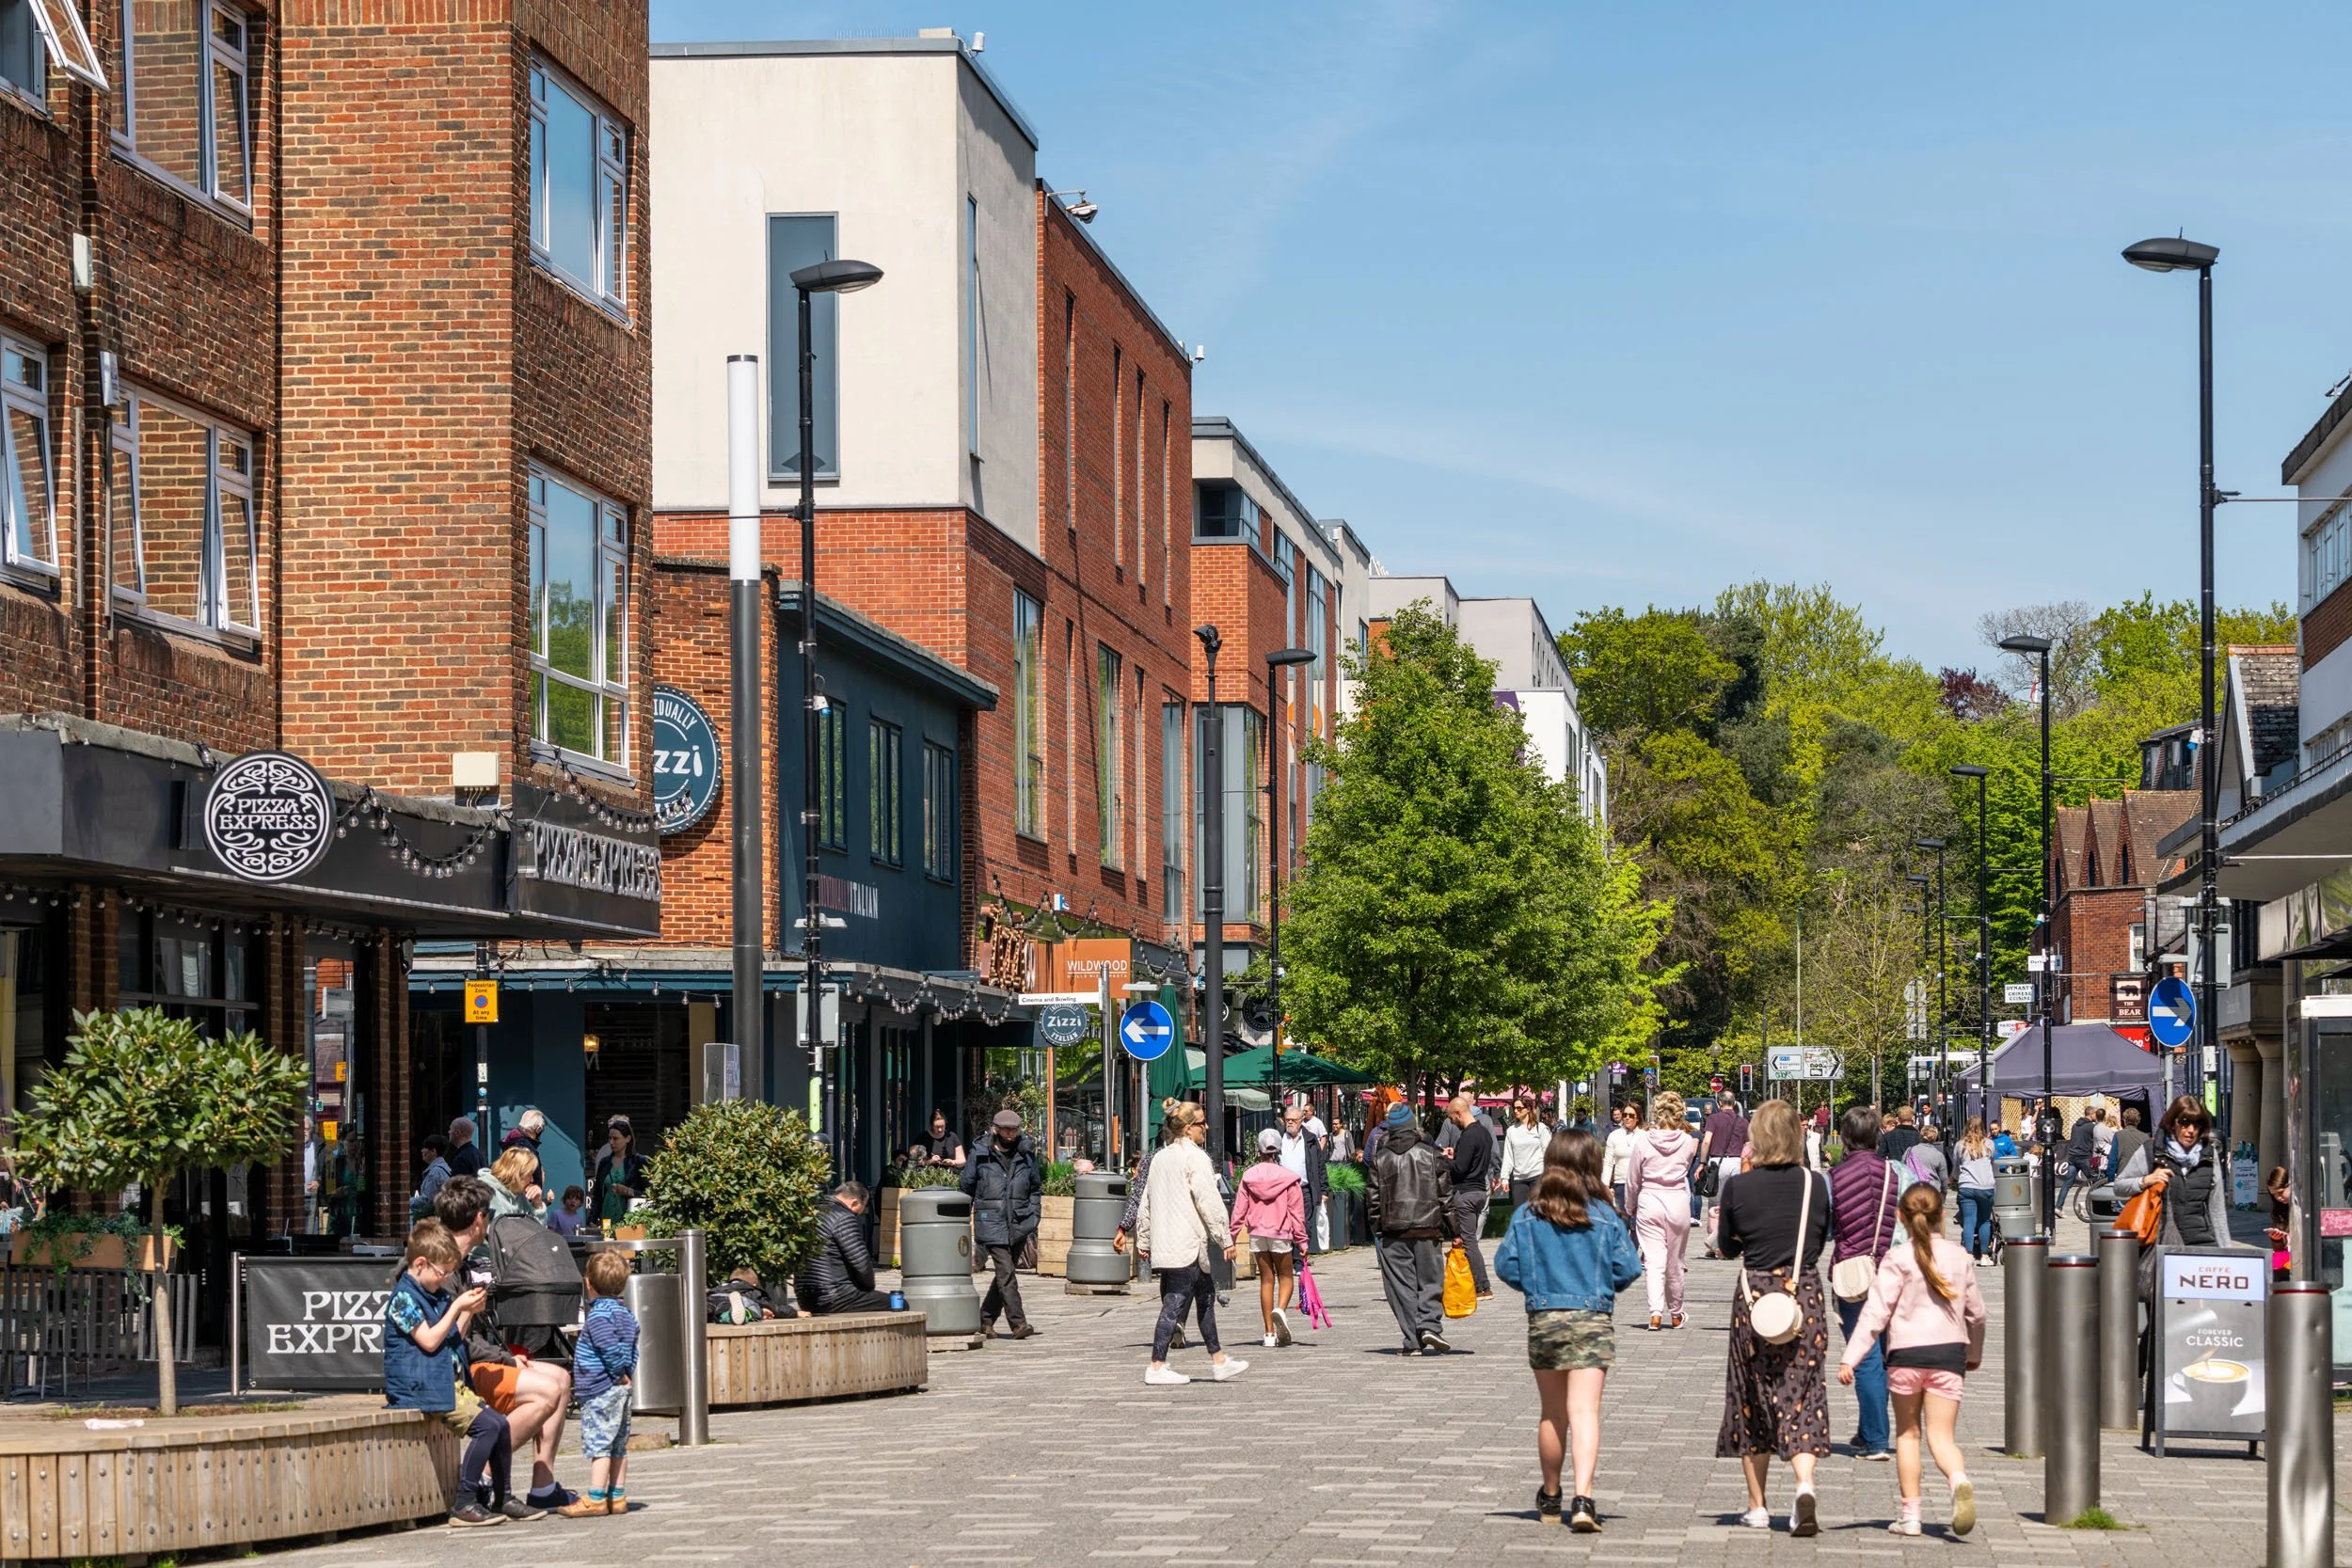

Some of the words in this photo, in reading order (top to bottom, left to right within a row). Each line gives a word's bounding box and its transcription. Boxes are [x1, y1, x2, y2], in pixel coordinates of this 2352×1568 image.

[237, 799, 299, 814] PIZZA
[219, 815, 317, 830] EXPRESS
[850, 880, 879, 920] ITALIAN
[1067, 959, 1128, 972] WILDWOOD
[1047, 1016, 1082, 1027] Zizzi
[1051, 1031, 1079, 1042] ITALIAN
[2179, 1275, 2249, 1290] NERO
[302, 1291, 393, 1321] PIZZ
[266, 1323, 386, 1354] EXPR
[2185, 1336, 2244, 1348] CLASSIC
